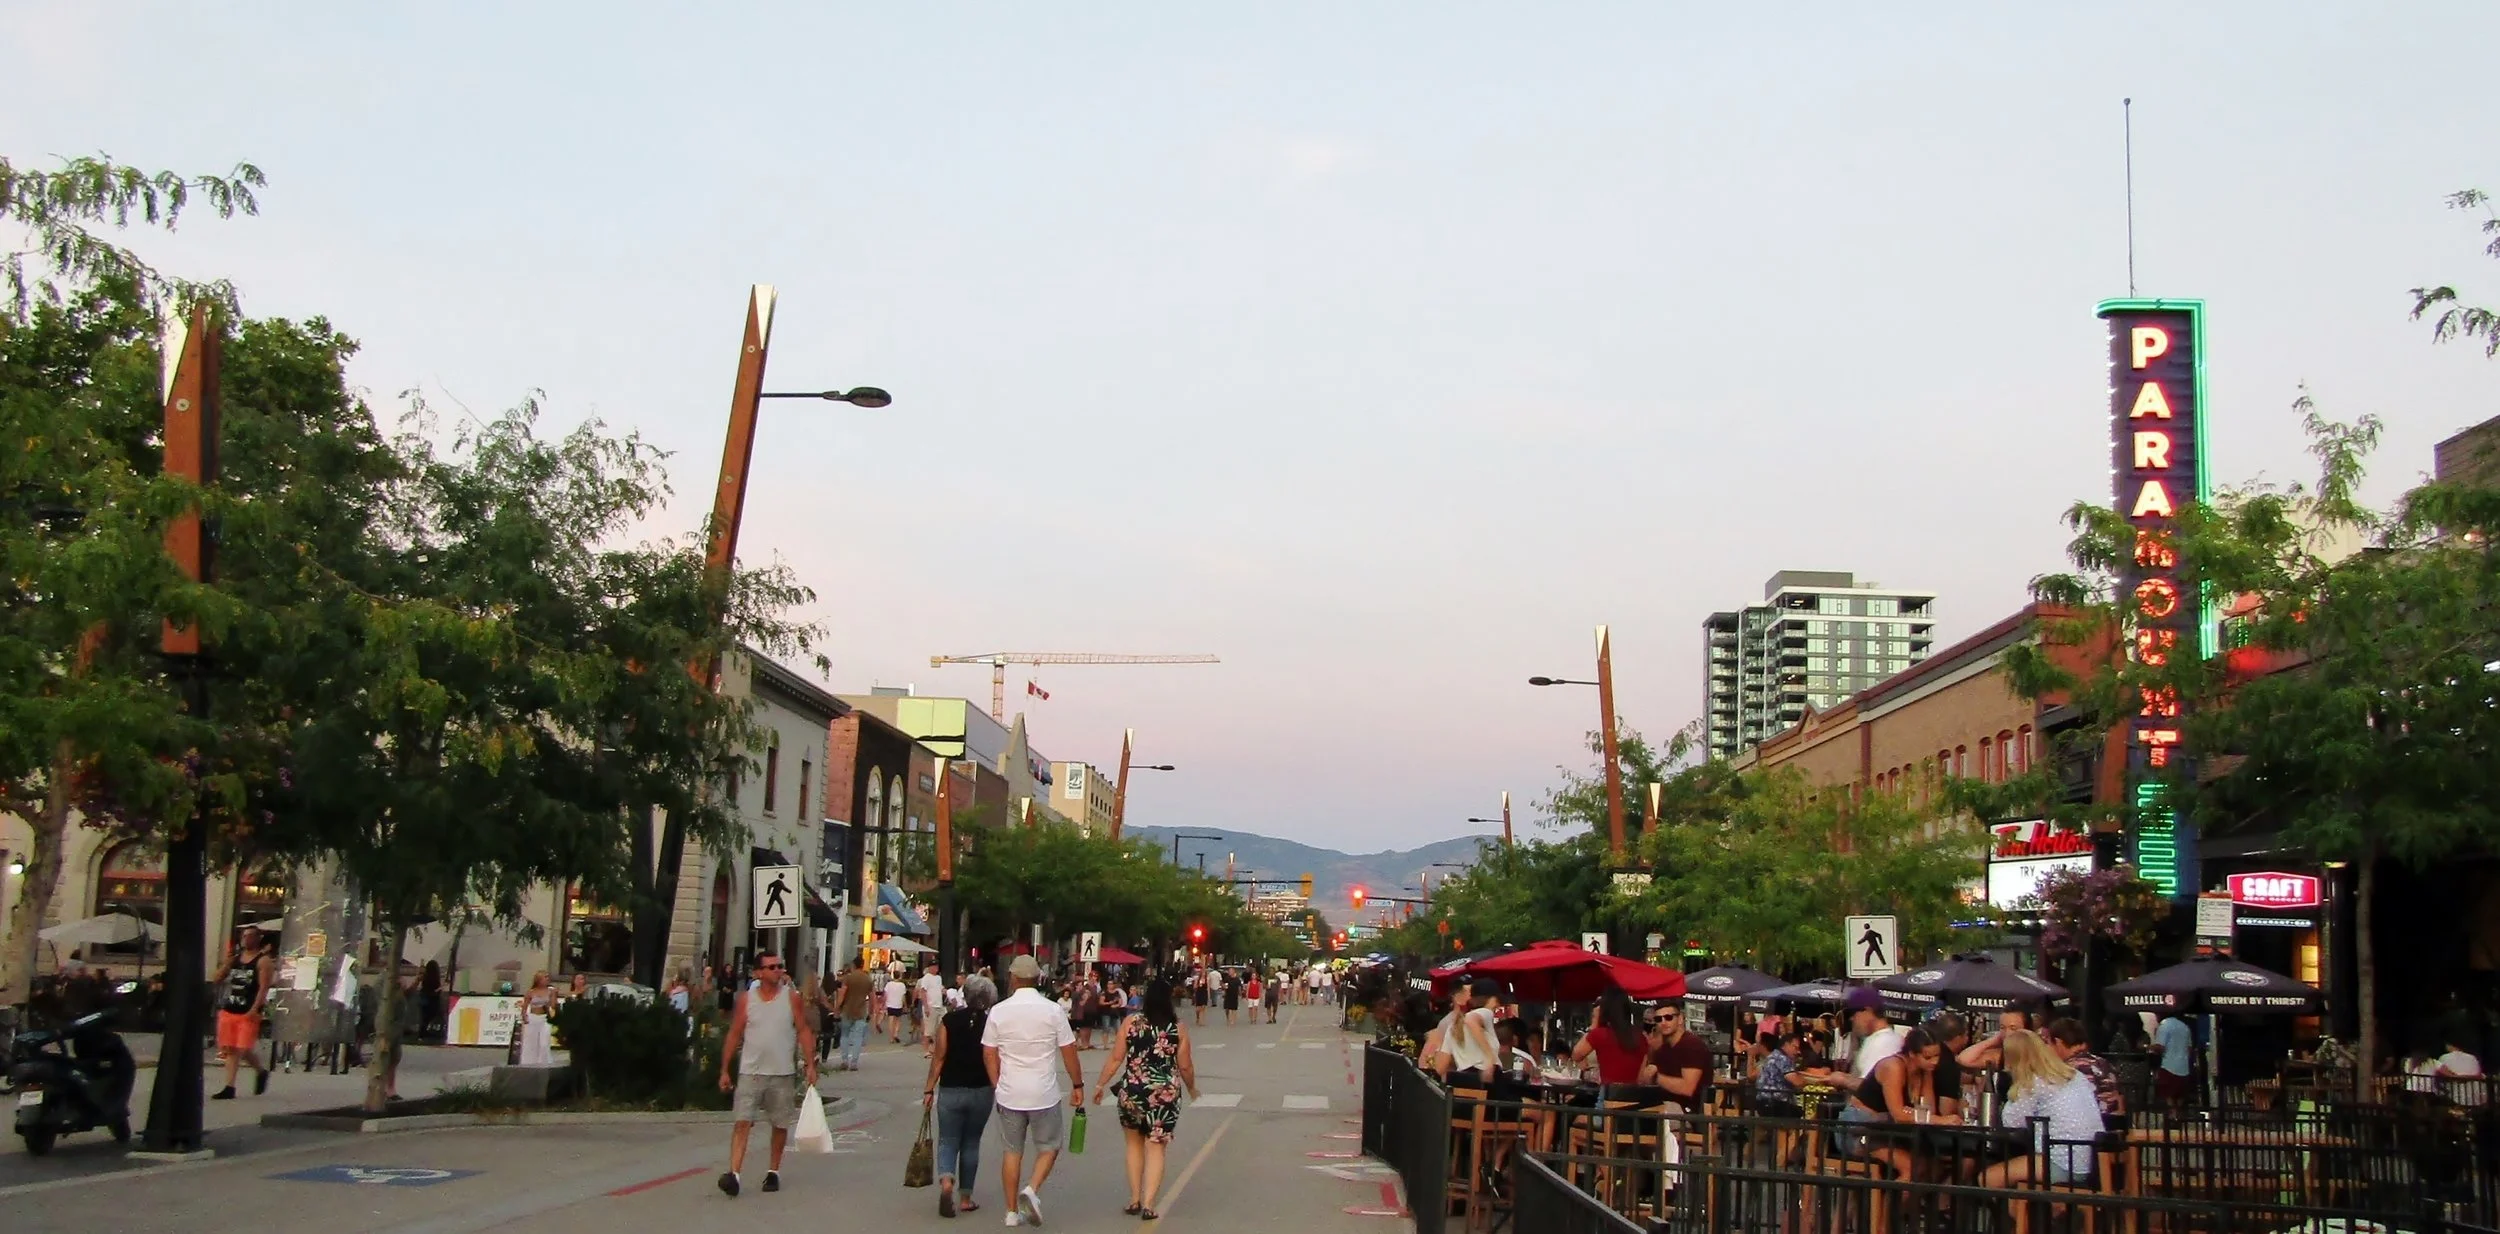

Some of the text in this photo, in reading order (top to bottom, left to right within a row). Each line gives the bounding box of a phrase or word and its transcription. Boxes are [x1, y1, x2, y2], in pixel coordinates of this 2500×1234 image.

[2129, 326, 2181, 767] PARAMOUNT
[2020, 866, 2035, 878] TRY
[2242, 878, 2304, 898] CRAFT
[1683, 993, 1707, 1001] DRIVEN
[1878, 989, 1936, 1002] DRIVEN BY THIRST!
[2124, 995, 2165, 1006] PARALLEL
[2211, 996, 2305, 1006] DRIVEN BY THIRST!
[489, 1013, 512, 1021] HAPPY
